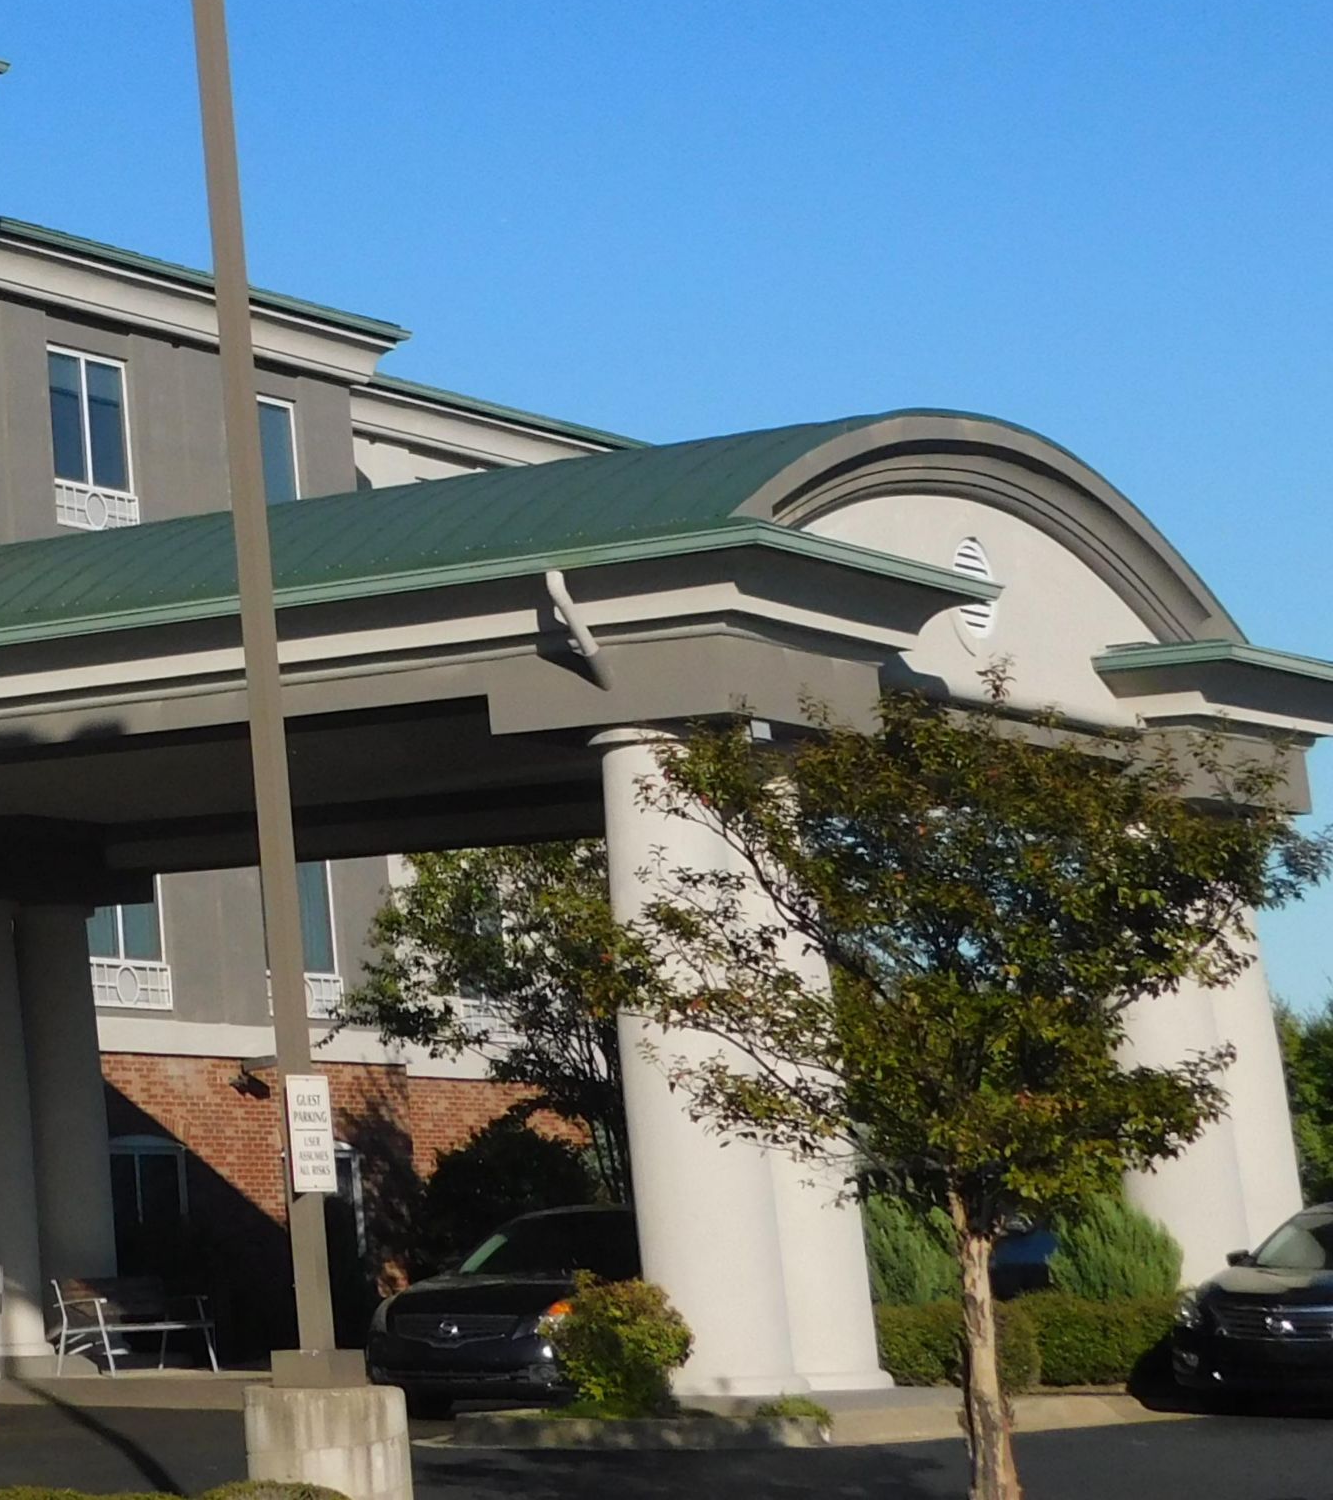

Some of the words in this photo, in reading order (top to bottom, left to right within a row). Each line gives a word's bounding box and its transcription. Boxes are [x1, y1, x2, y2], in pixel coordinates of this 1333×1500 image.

[296, 1094, 321, 1106] GUEST
[293, 1111, 327, 1123] PARKING
[303, 1136, 321, 1147] USER
[312, 1165, 331, 1176] RISKS
